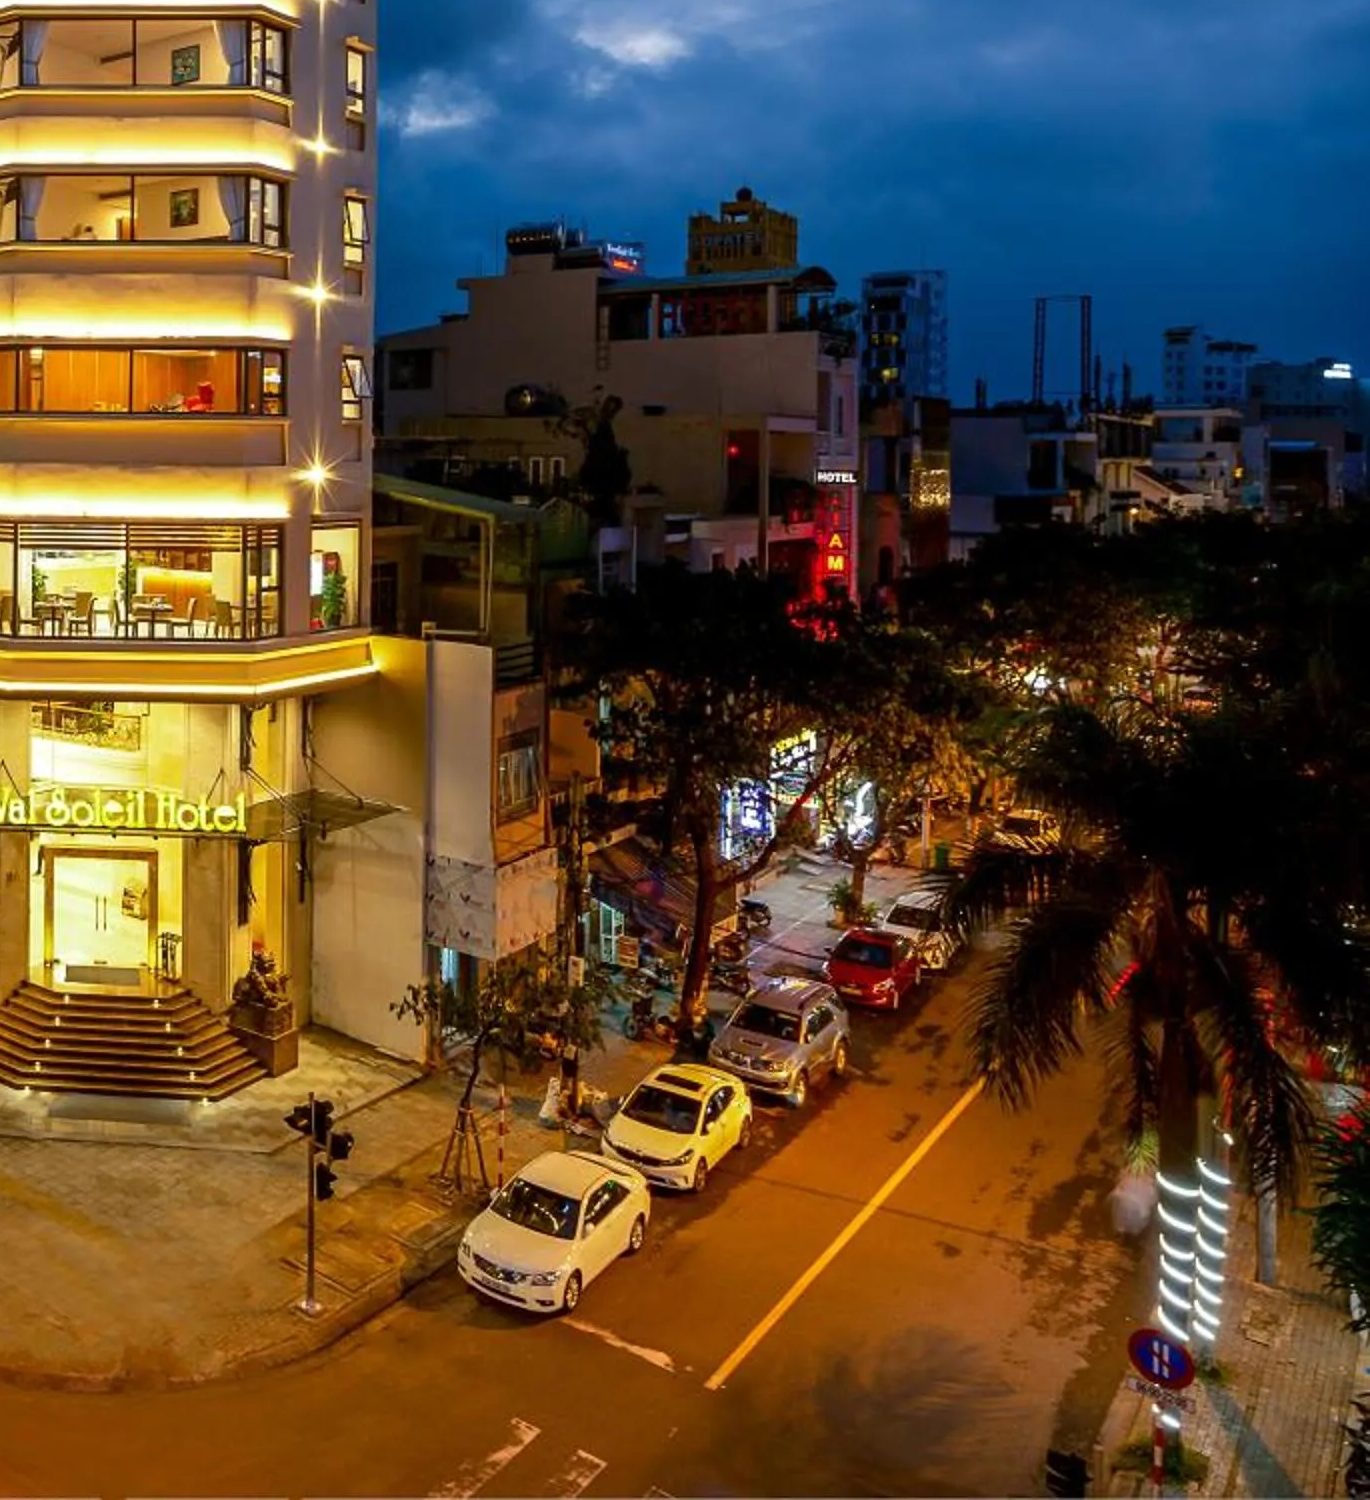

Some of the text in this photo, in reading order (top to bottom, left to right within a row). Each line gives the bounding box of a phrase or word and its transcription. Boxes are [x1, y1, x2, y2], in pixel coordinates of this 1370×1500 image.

[817, 472, 857, 483] HOTEL
[45, 786, 146, 828] Soleil
[155, 789, 247, 832] Hotel
